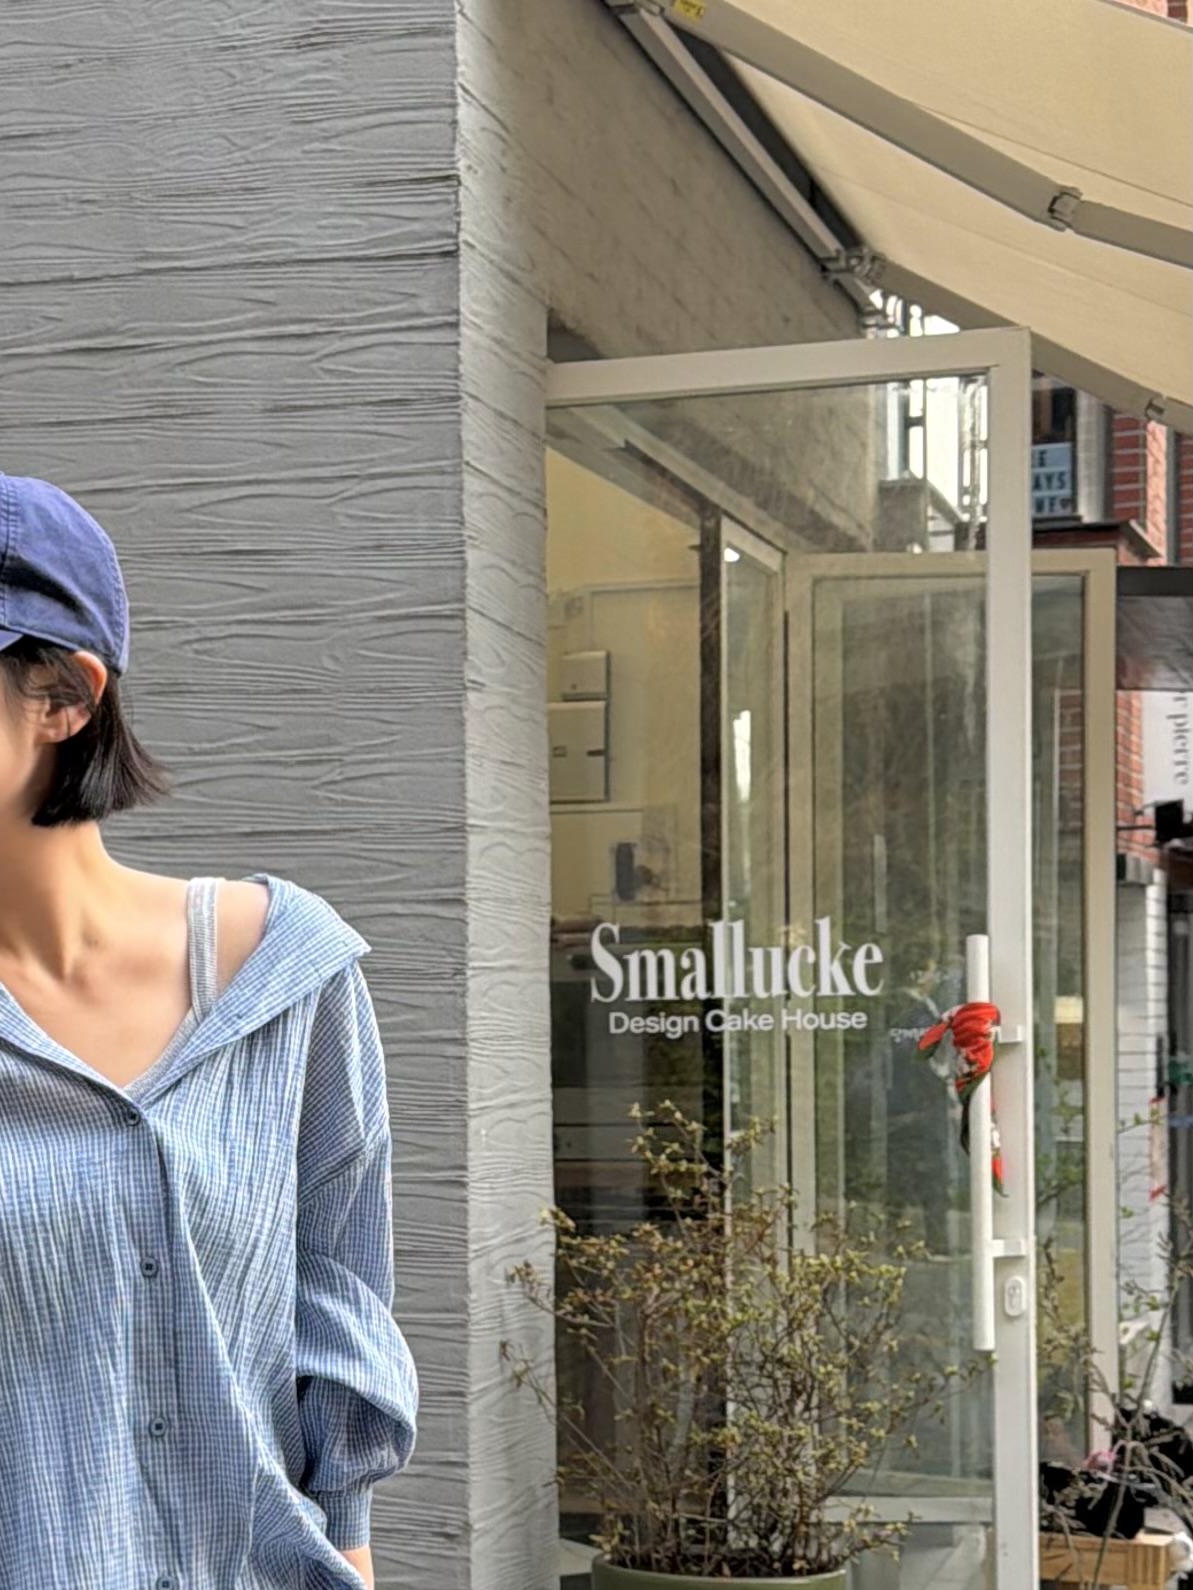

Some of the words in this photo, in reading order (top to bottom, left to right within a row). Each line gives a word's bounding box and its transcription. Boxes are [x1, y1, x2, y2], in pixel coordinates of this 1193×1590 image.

[1032, 471, 1066, 491] AYS
[590, 915, 884, 1003] Smallucke
[609, 1010, 700, 1039] Design
[705, 1008, 774, 1031] Cake
[782, 1005, 868, 1030] House
